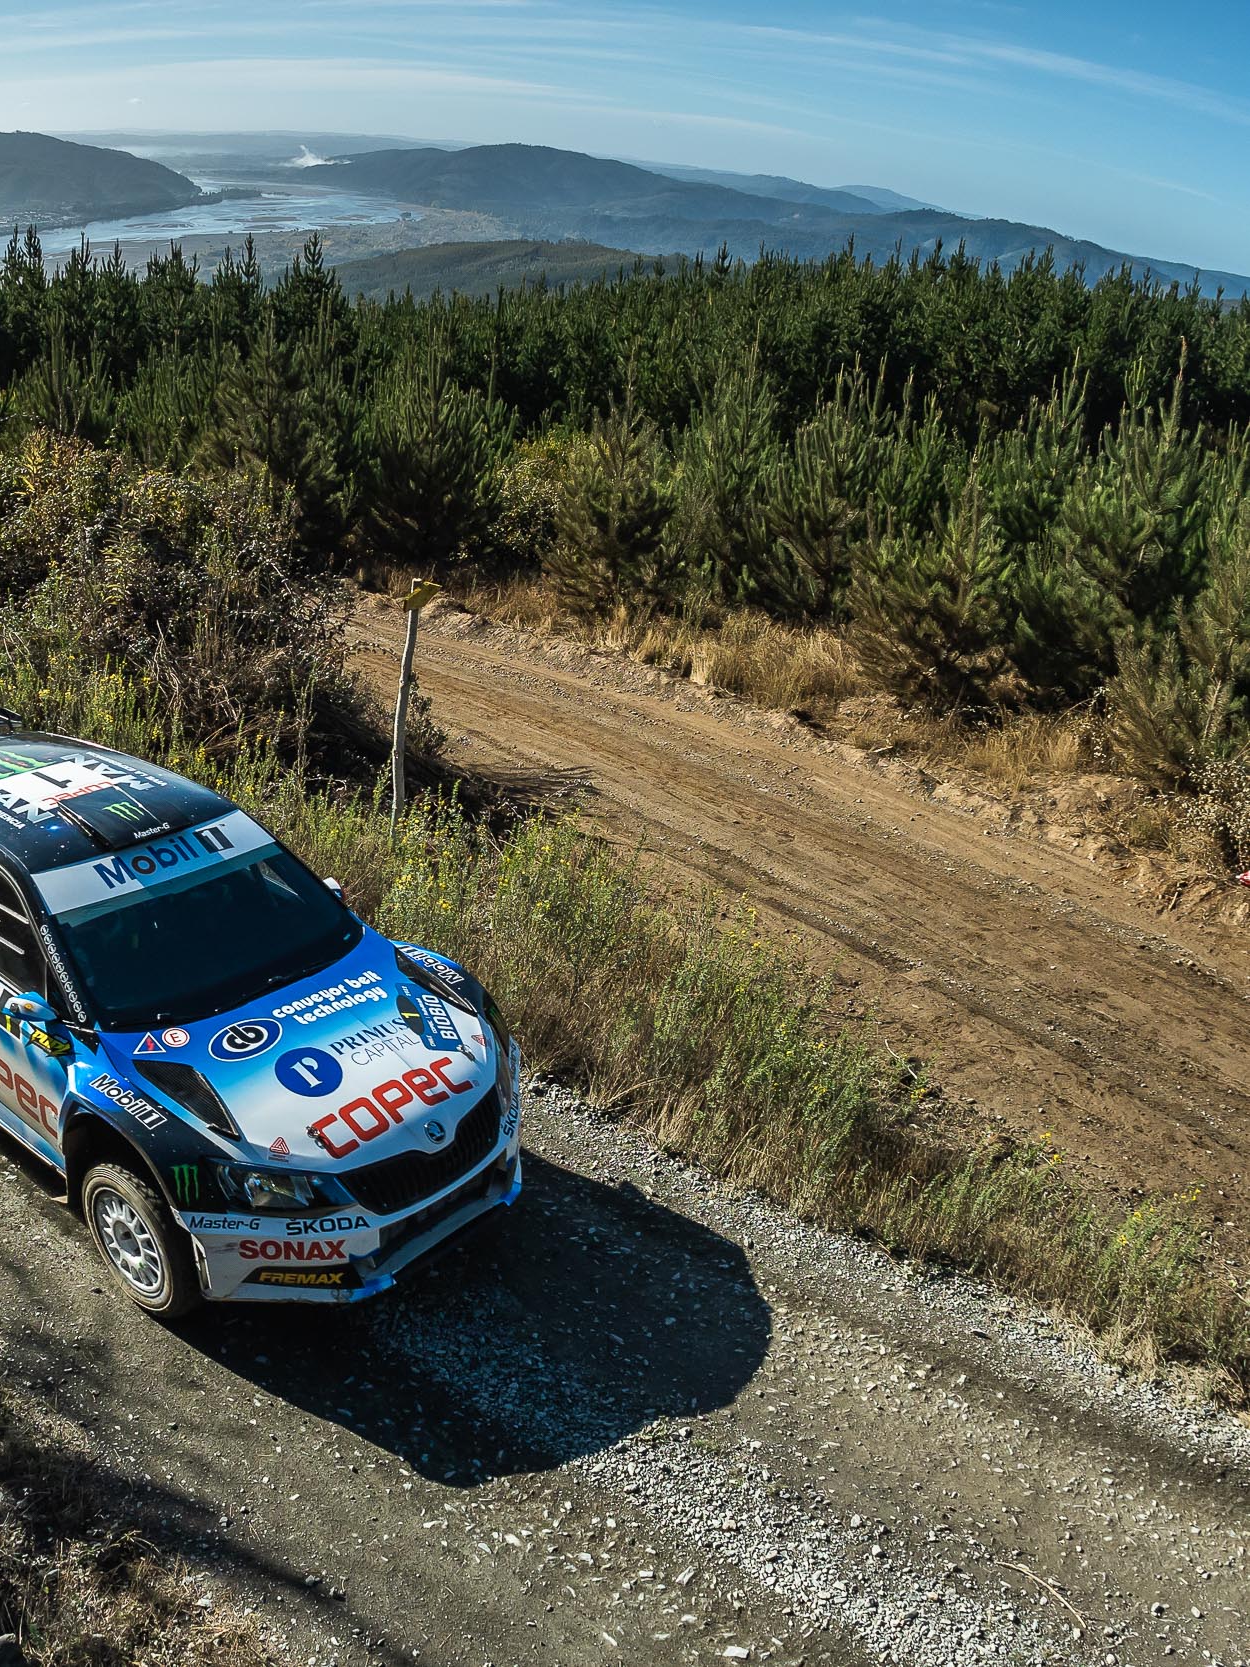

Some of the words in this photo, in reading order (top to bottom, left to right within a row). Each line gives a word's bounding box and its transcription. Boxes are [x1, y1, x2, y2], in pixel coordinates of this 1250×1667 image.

[31, 771, 72, 789] 1
[133, 822, 171, 839] Master-G
[93, 836, 200, 889] Mobil
[415, 952, 465, 985] Mobil
[272, 983, 349, 1018] conveyor
[344, 970, 382, 989] belt
[292, 986, 388, 1025] technology
[169, 1032, 182, 1043] E
[328, 1016, 409, 1055] PRIMUS
[351, 1034, 421, 1066] CAPITAL
[89, 1073, 150, 1115] Mobil
[189, 1215, 261, 1231] Master-G
[285, 1215, 370, 1236] ŠKODA
[239, 1239, 347, 1261] SONAX
[259, 1272, 344, 1285] FREMAX
